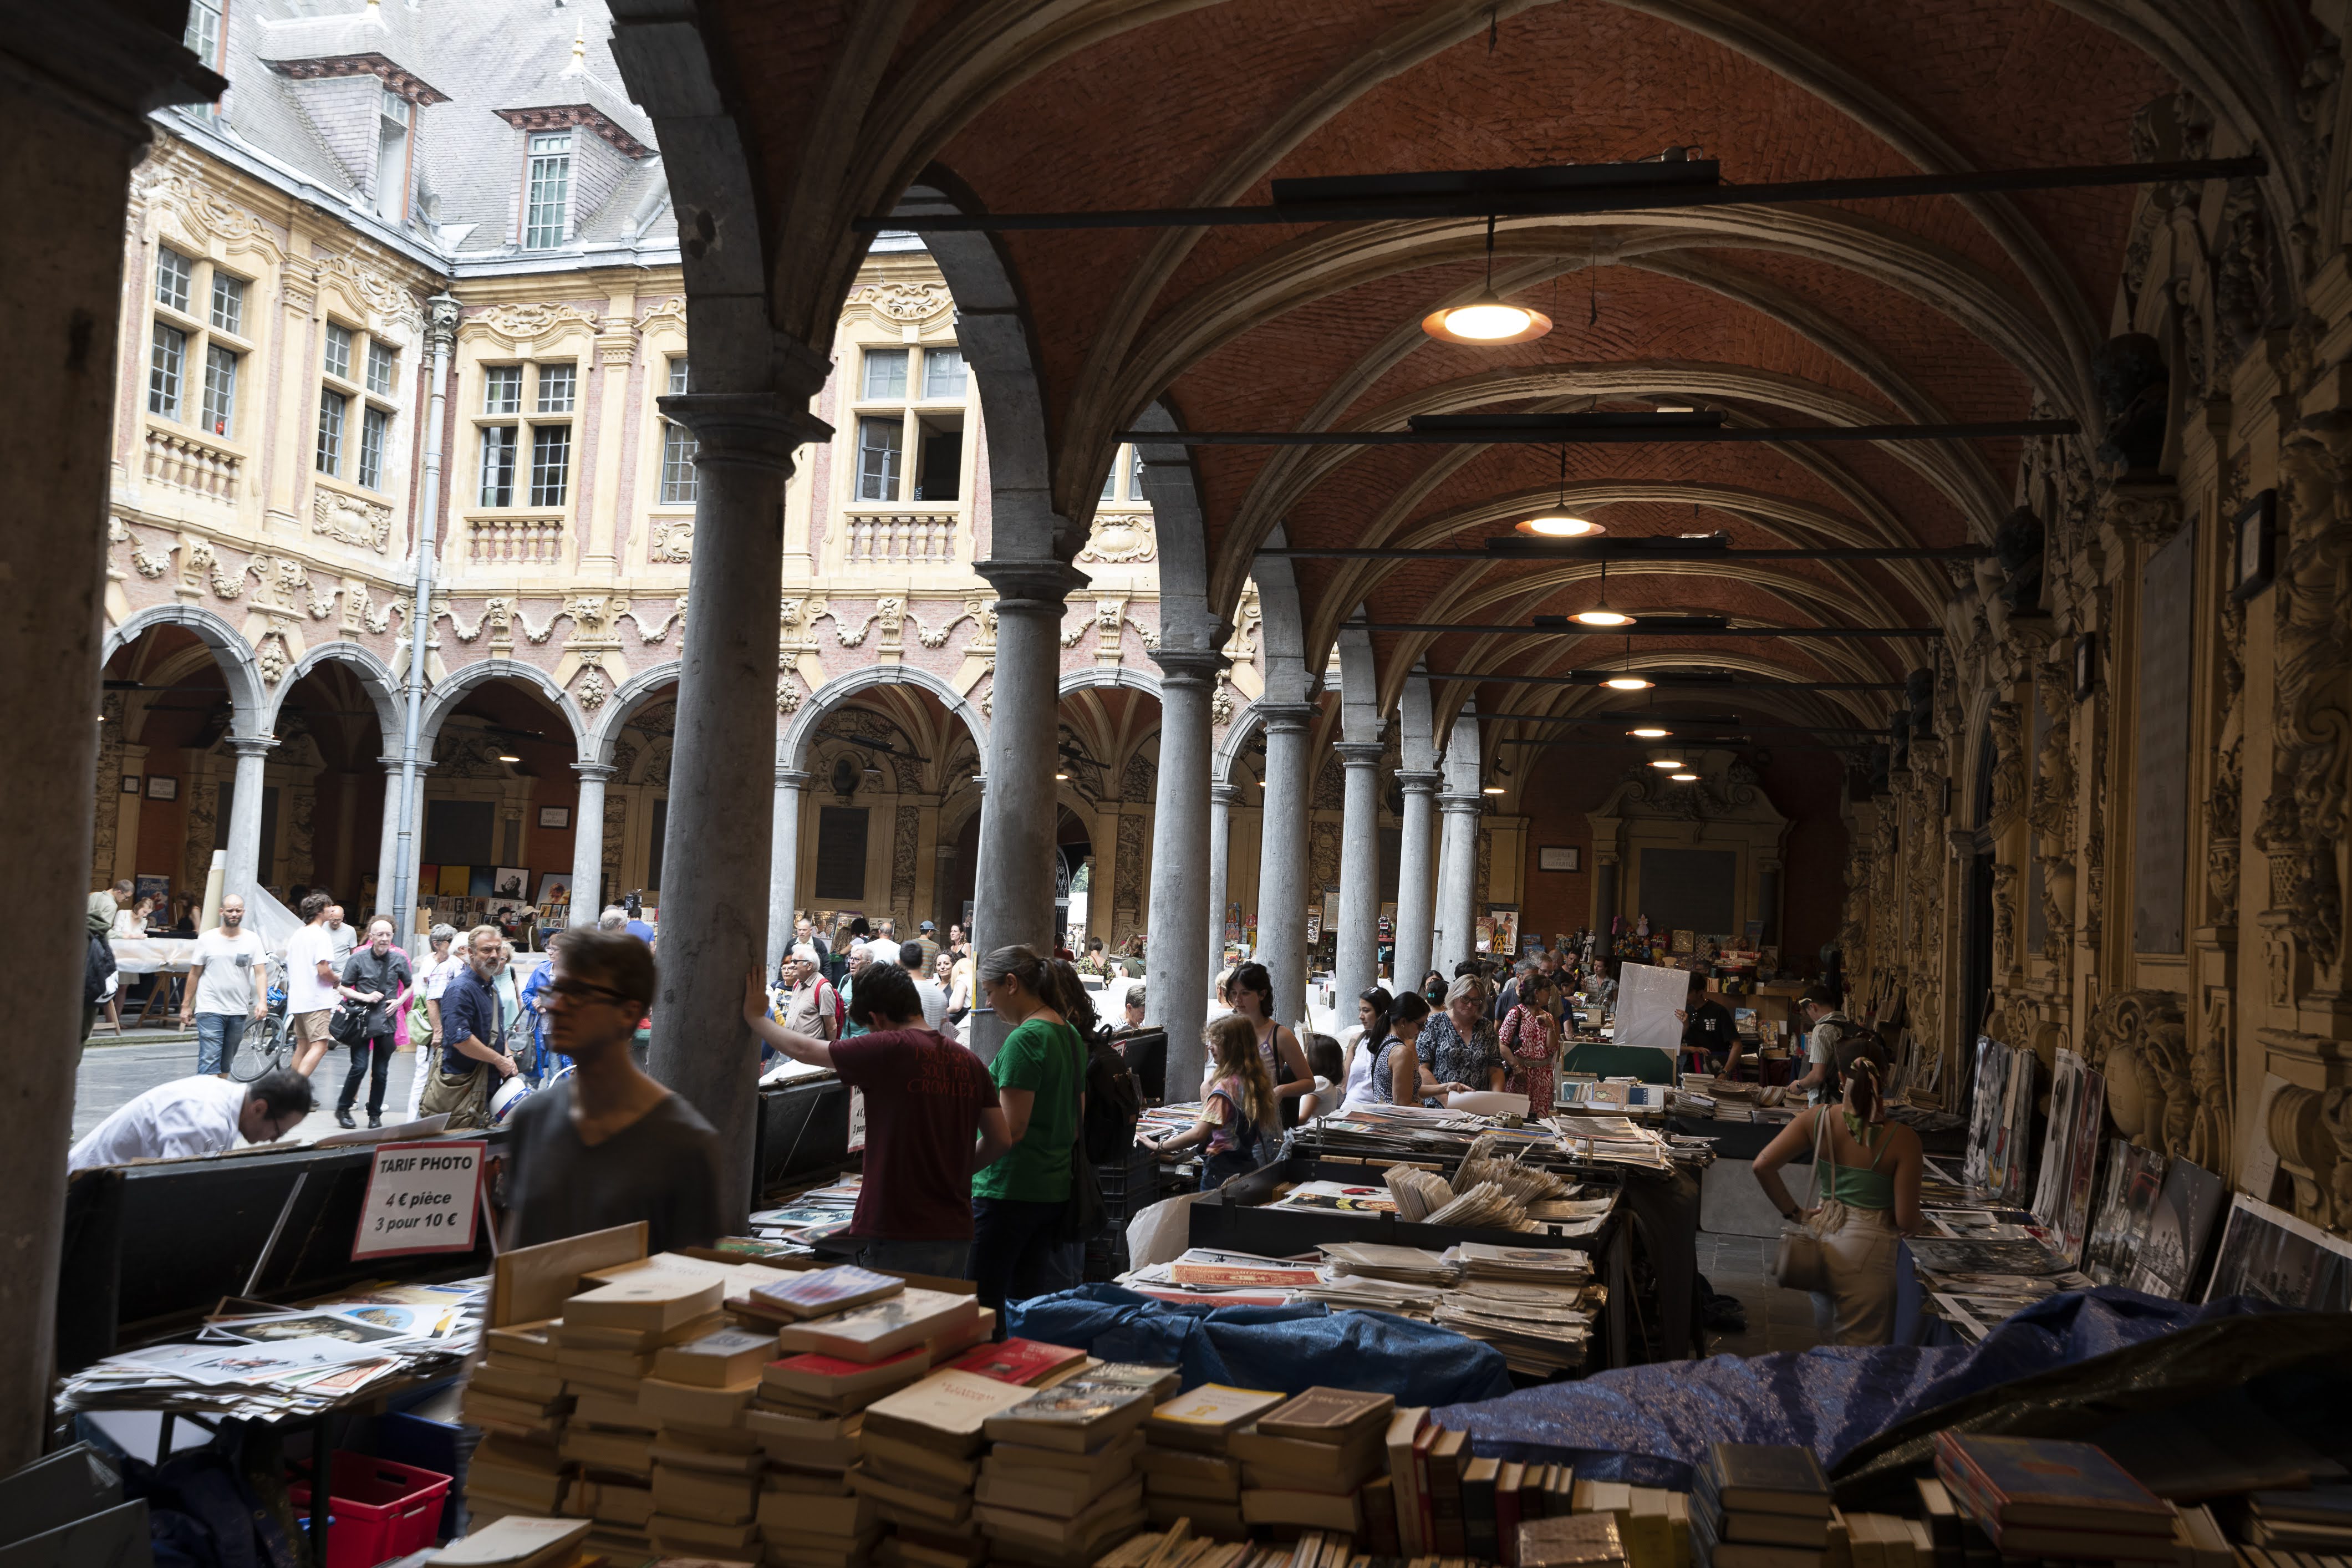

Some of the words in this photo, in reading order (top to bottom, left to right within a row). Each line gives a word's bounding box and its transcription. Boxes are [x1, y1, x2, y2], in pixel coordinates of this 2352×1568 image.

[915, 1047, 919, 1060] I
[923, 1047, 949, 1065] SOLD
[923, 1064, 949, 1080] SOUL
[954, 1066, 969, 1078] TO
[908, 1078, 976, 1096] CROWLEY
[857, 1108, 860, 1117] 4
[860, 1108, 863, 1117] €
[853, 1124, 857, 1133] 3
[380, 1157, 416, 1174] TARIF
[420, 1156, 472, 1170] PHOTO
[386, 1193, 395, 1206] 4
[399, 1193, 408, 1205] €
[410, 1192, 452, 1209] pièce
[375, 1218, 384, 1231] 3
[386, 1218, 420, 1233] pour
[425, 1214, 443, 1226] 10
[447, 1213, 457, 1225] €
